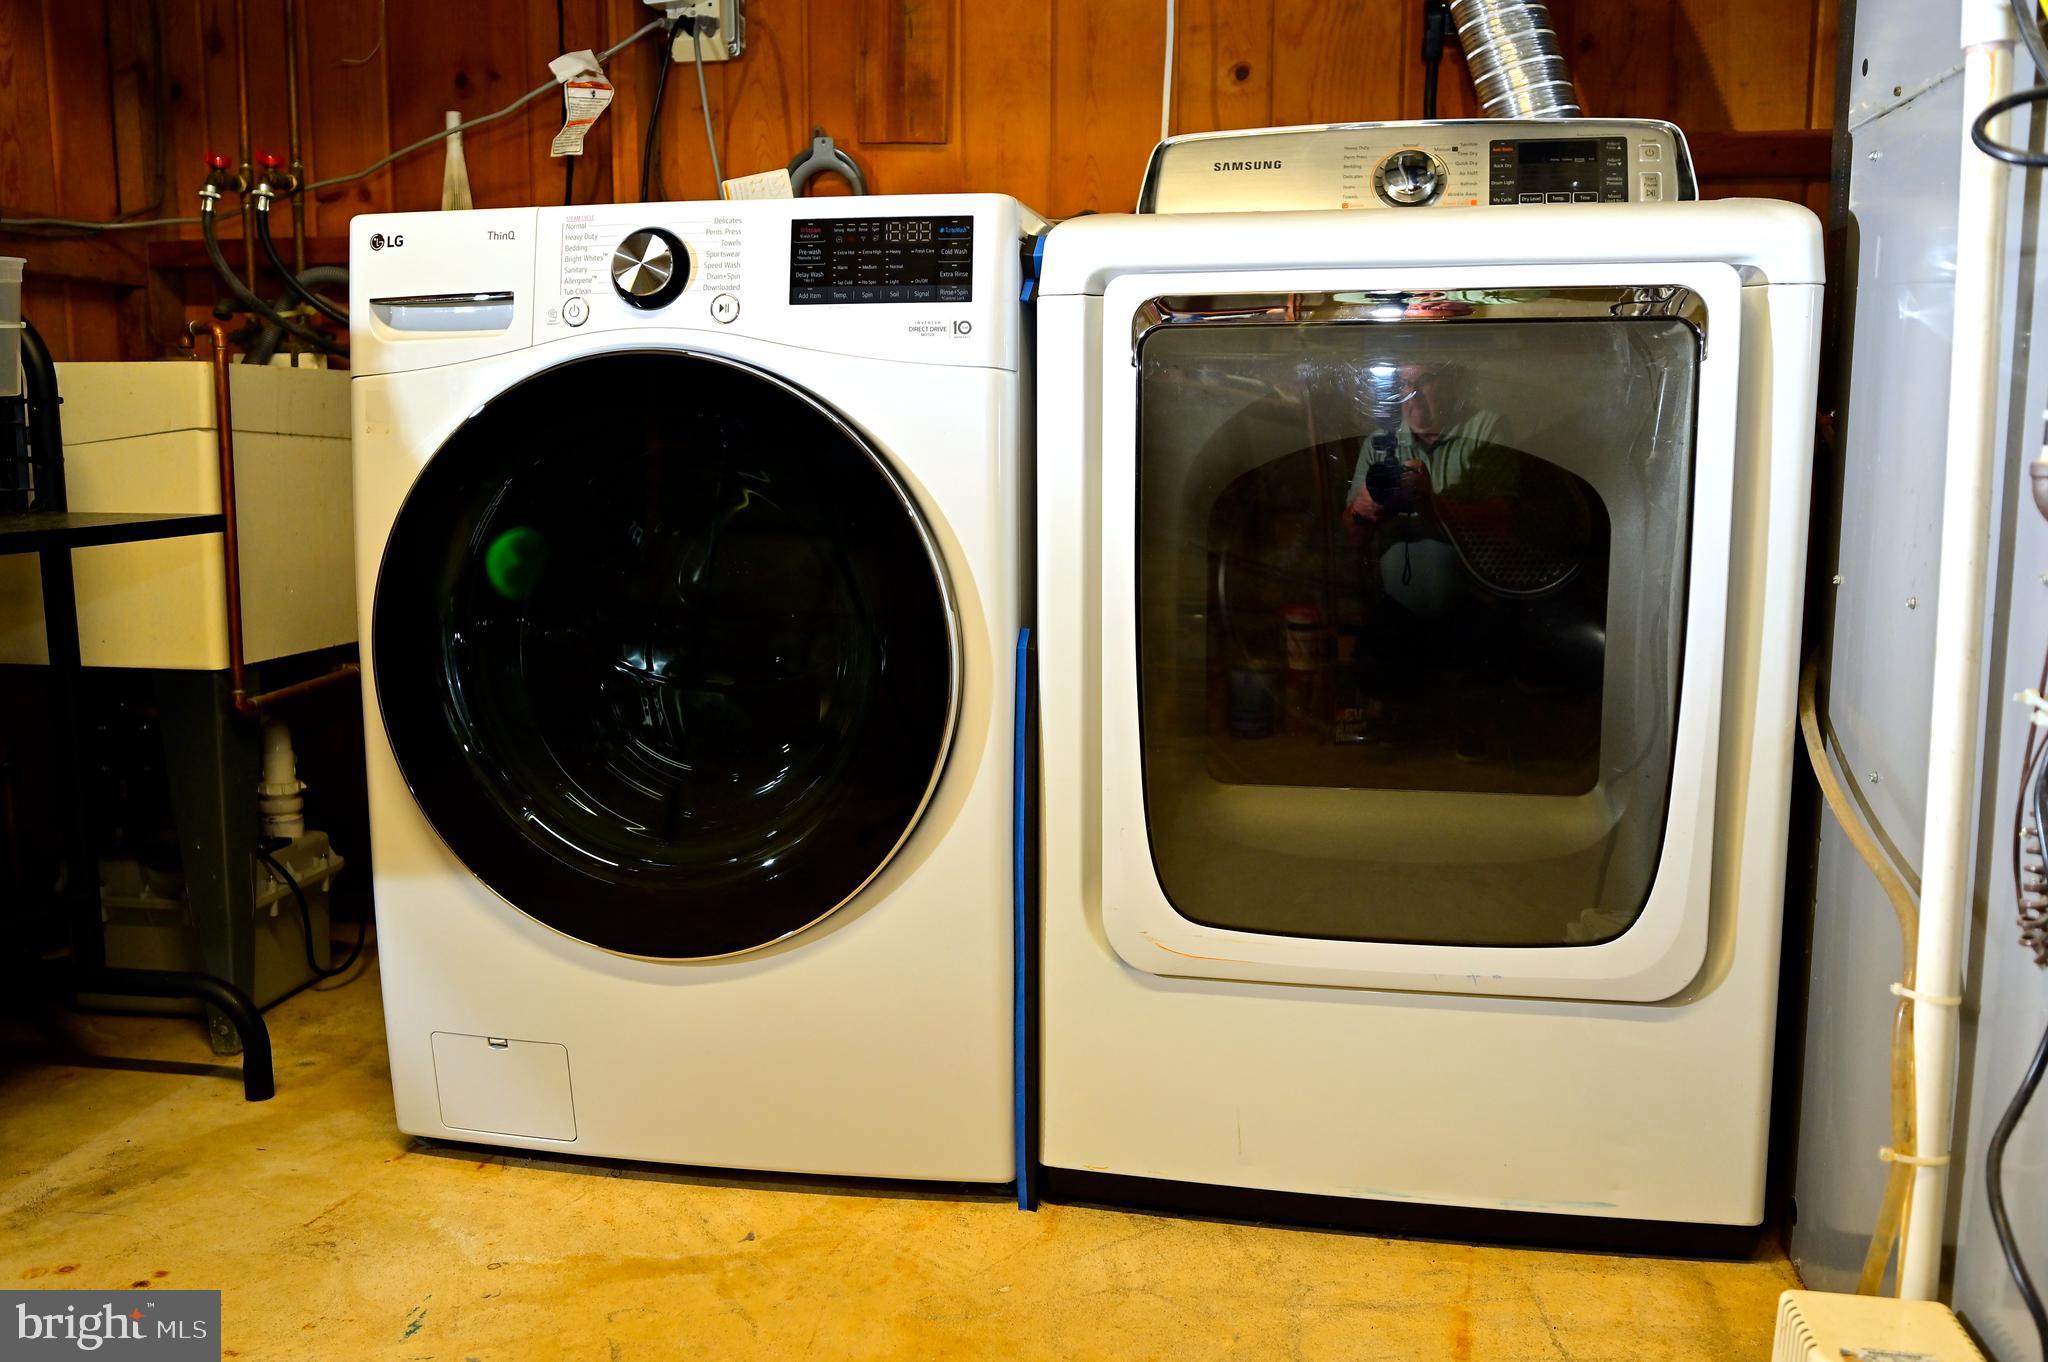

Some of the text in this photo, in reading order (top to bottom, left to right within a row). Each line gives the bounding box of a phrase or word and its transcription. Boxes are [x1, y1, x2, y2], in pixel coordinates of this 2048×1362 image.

[1214, 160, 1282, 171] SAMSUNG
[714, 217, 742, 225] Delicates
[488, 230, 516, 241] ThinQ
[584, 233, 598, 241] Duty
[386, 235, 404, 248] LG
[706, 250, 741, 258] Sportswear
[564, 255, 582, 263] Bright
[703, 261, 741, 270] Speed Wash
[795, 271, 809, 279] Delay
[914, 290, 930, 298] Signal
[953, 320, 972, 335] 10
